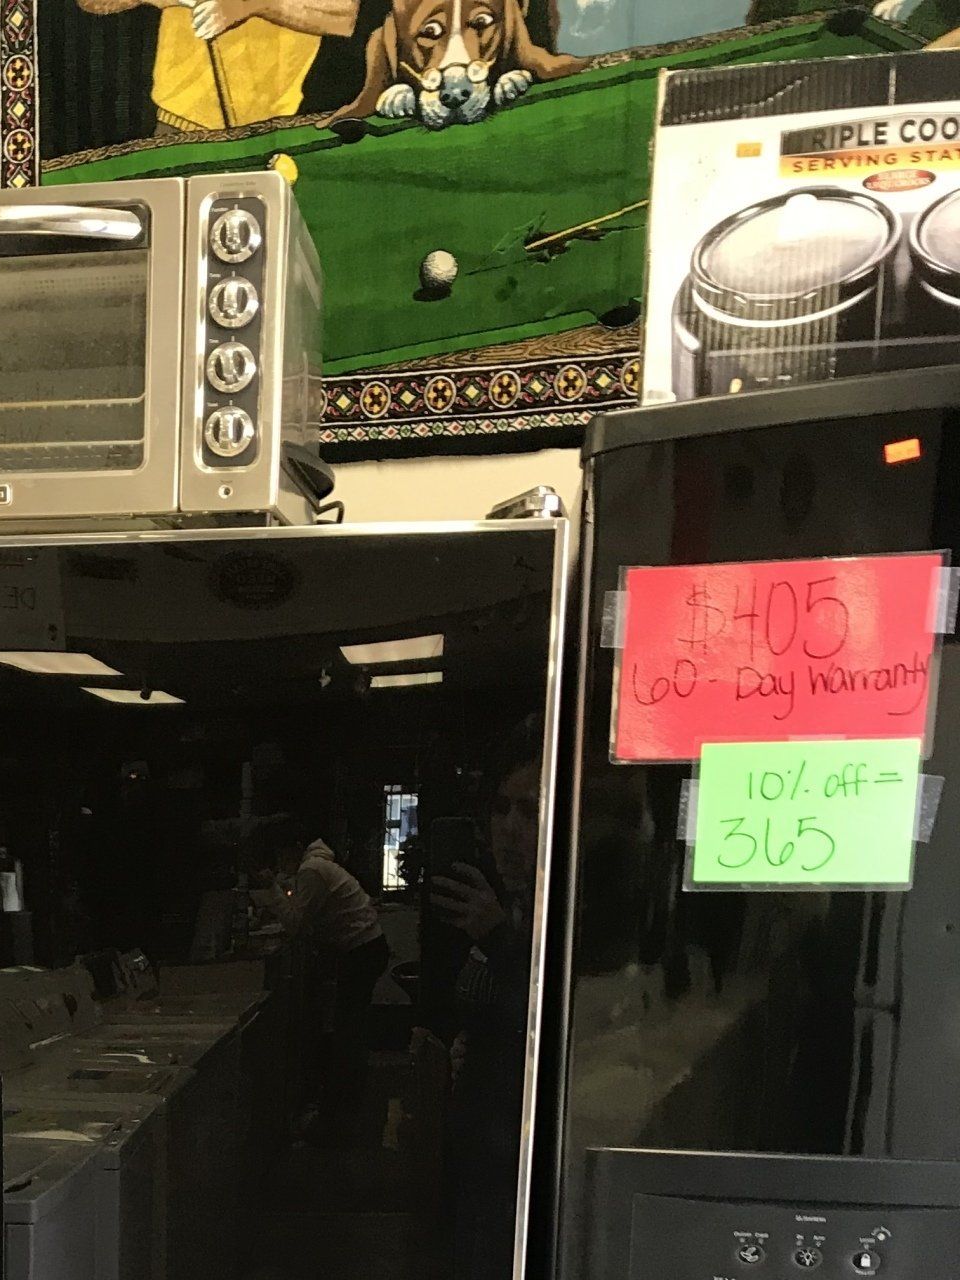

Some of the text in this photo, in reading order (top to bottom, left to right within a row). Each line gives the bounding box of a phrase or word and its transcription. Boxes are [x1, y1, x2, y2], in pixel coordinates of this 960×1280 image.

[796, 116, 960, 150] RIPLE COO
[792, 152, 899, 173] SERVING
[677, 576, 850, 662] $405
[748, 759, 811, 801] 10%
[717, 815, 836, 872] 365
